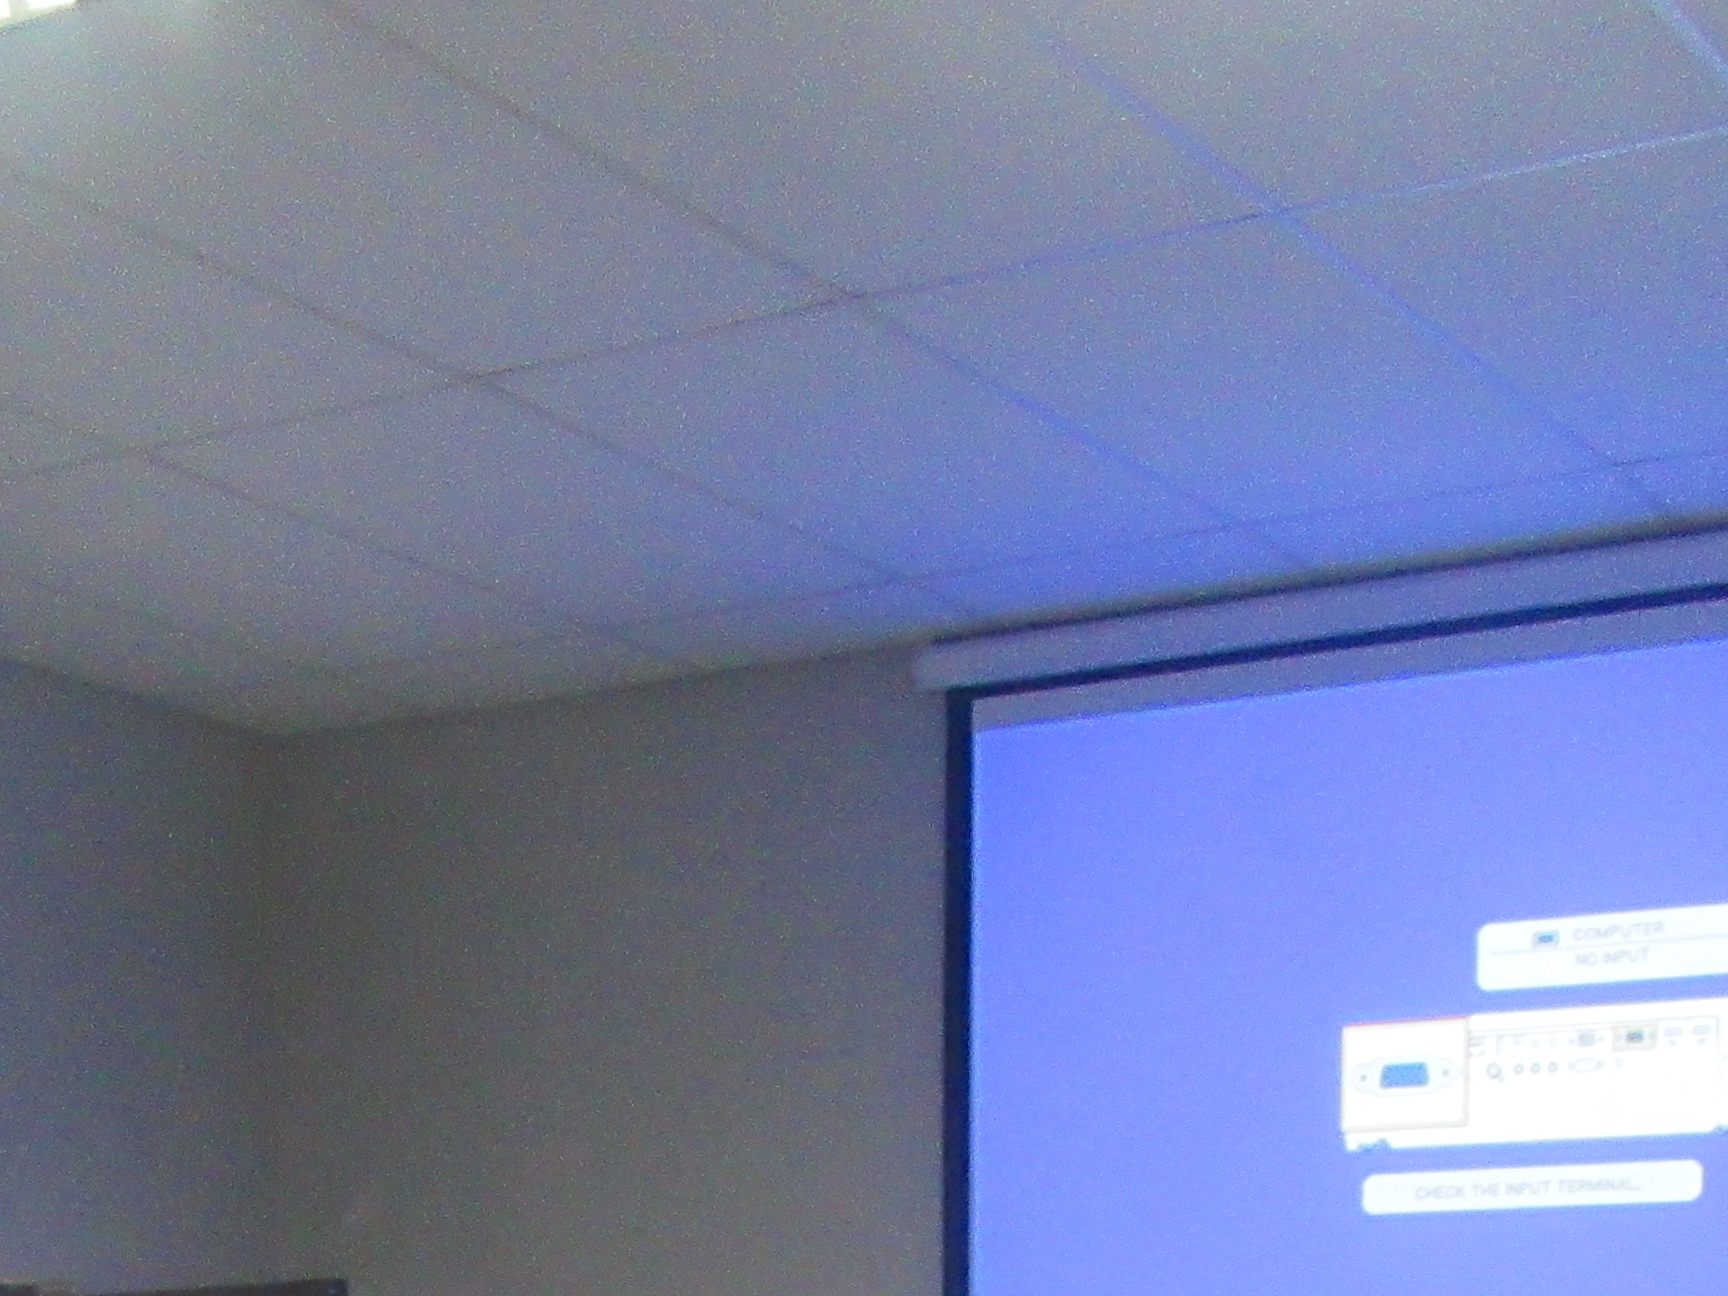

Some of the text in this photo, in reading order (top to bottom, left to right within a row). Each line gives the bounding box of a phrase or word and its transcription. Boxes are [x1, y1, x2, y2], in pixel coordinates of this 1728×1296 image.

[1573, 921, 1665, 941] COMPUTER
[1575, 946, 1650, 967] NO INPUT
[1415, 1184, 1465, 1201] CHECK
[1471, 1181, 1499, 1198] THE
[1504, 1179, 1552, 1196] INPUT
